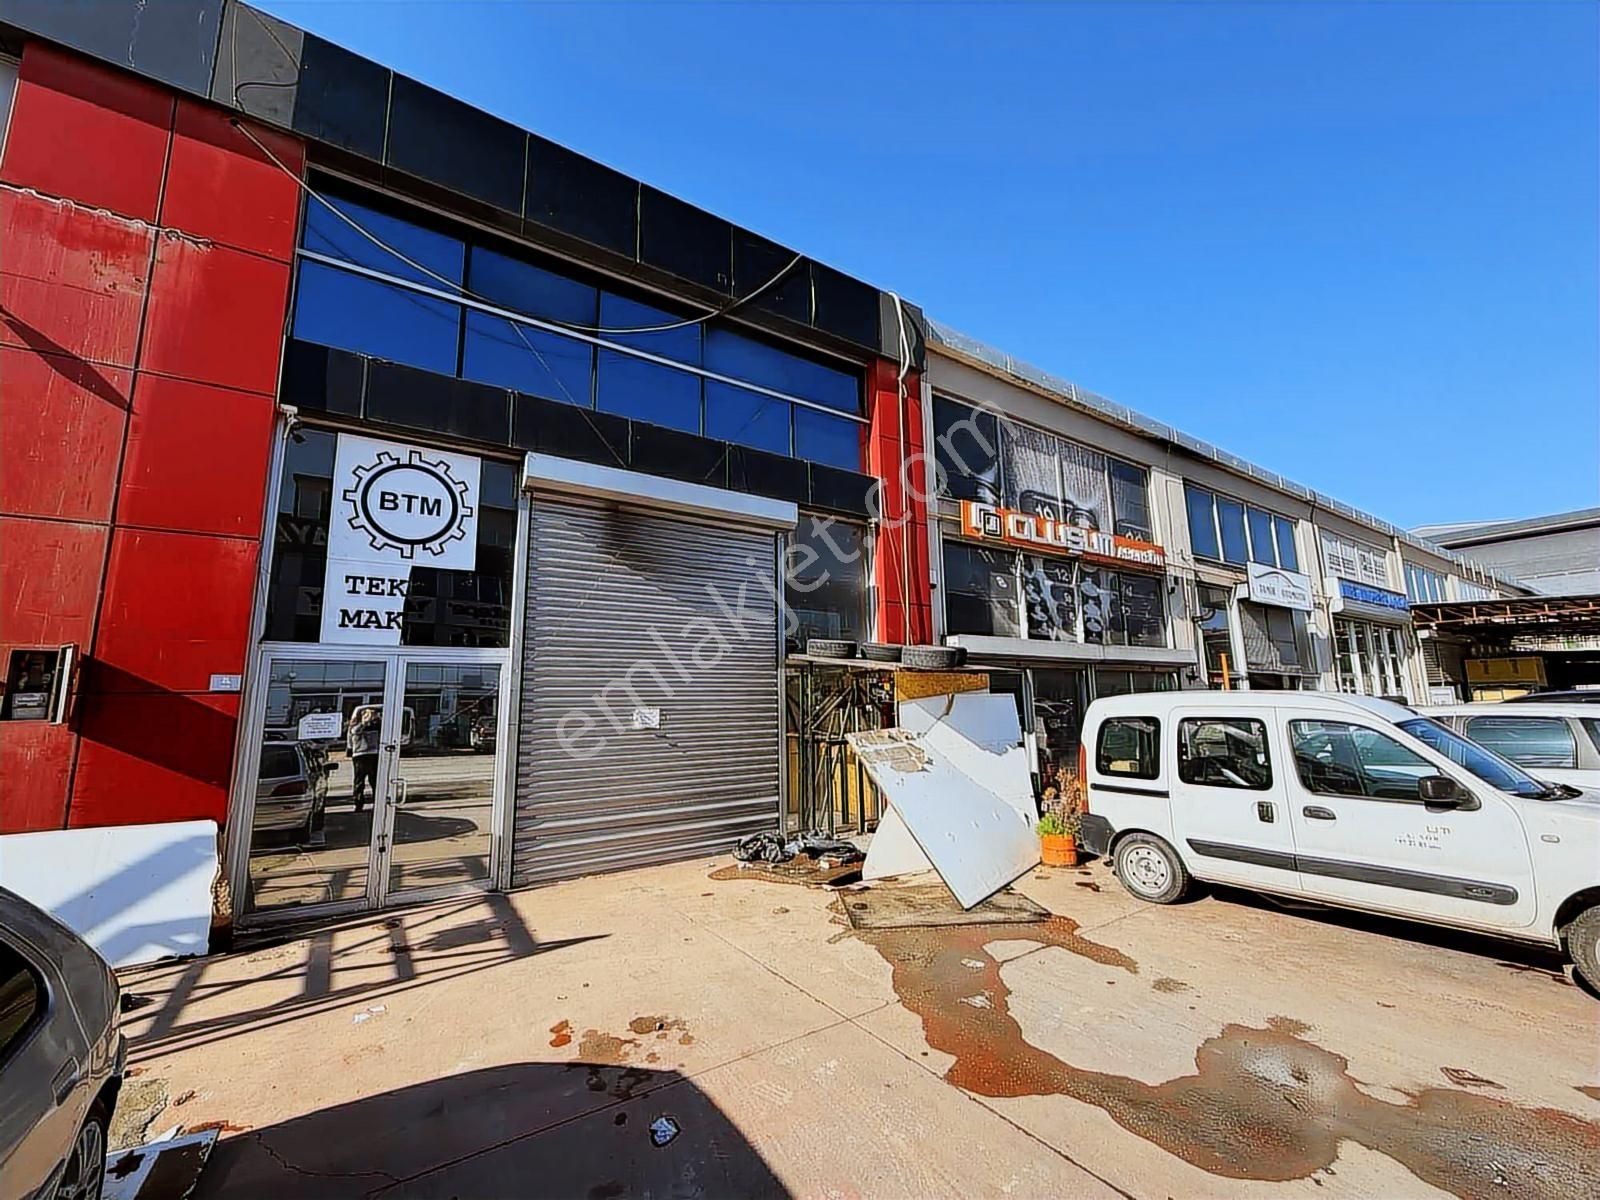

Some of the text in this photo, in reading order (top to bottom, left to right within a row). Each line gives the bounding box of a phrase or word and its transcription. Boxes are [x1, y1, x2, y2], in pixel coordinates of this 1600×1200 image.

[379, 490, 442, 517] BTM
[345, 575, 409, 598] TEK
[338, 608, 403, 630] MAK
